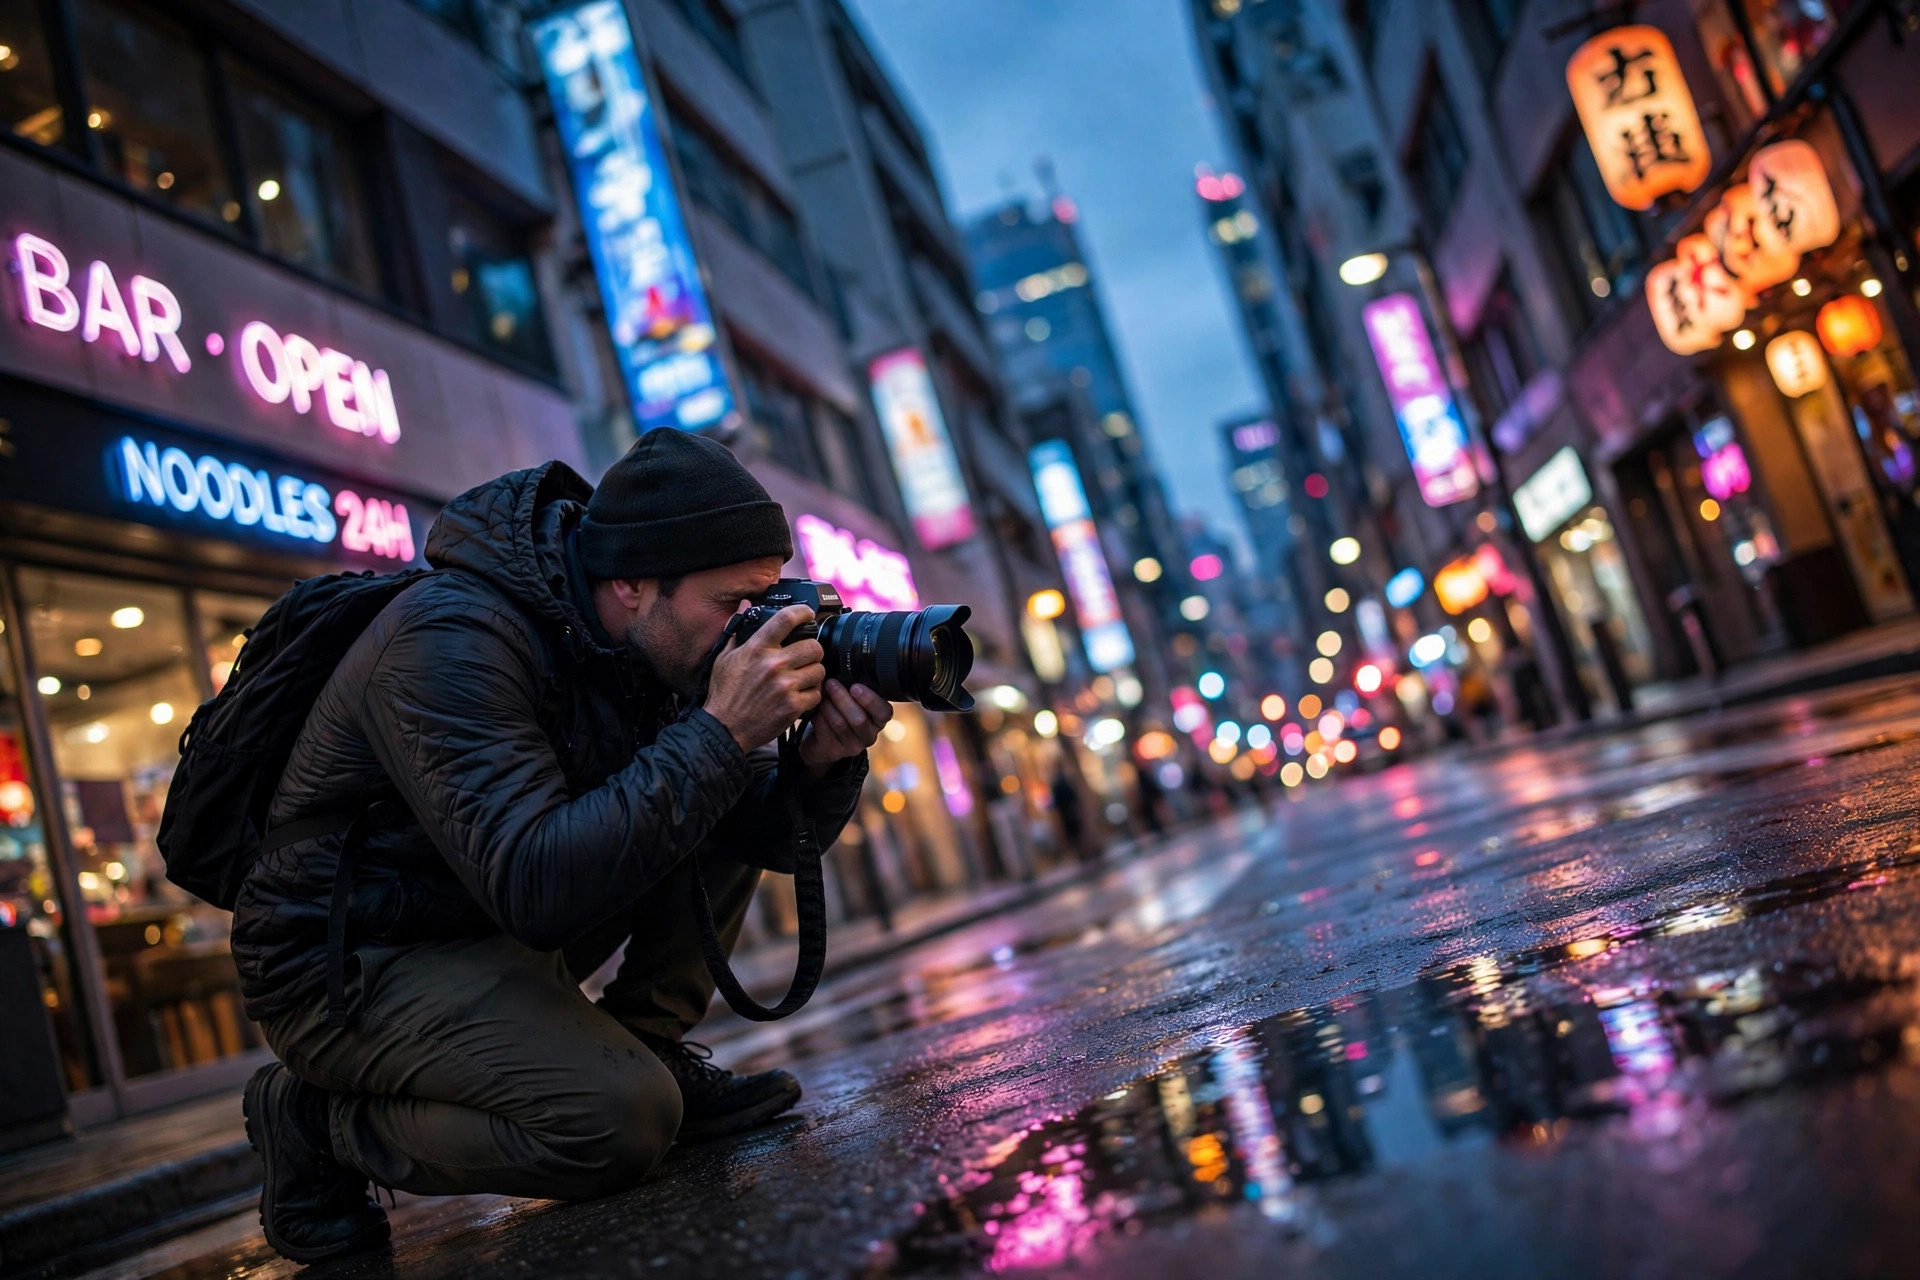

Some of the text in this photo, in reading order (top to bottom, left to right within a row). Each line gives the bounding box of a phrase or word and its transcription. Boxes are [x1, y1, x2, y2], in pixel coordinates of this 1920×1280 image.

[16, 232, 191, 373] BAR
[241, 321, 401, 444] OPEN
[121, 436, 415, 561] NOODLES 24H
